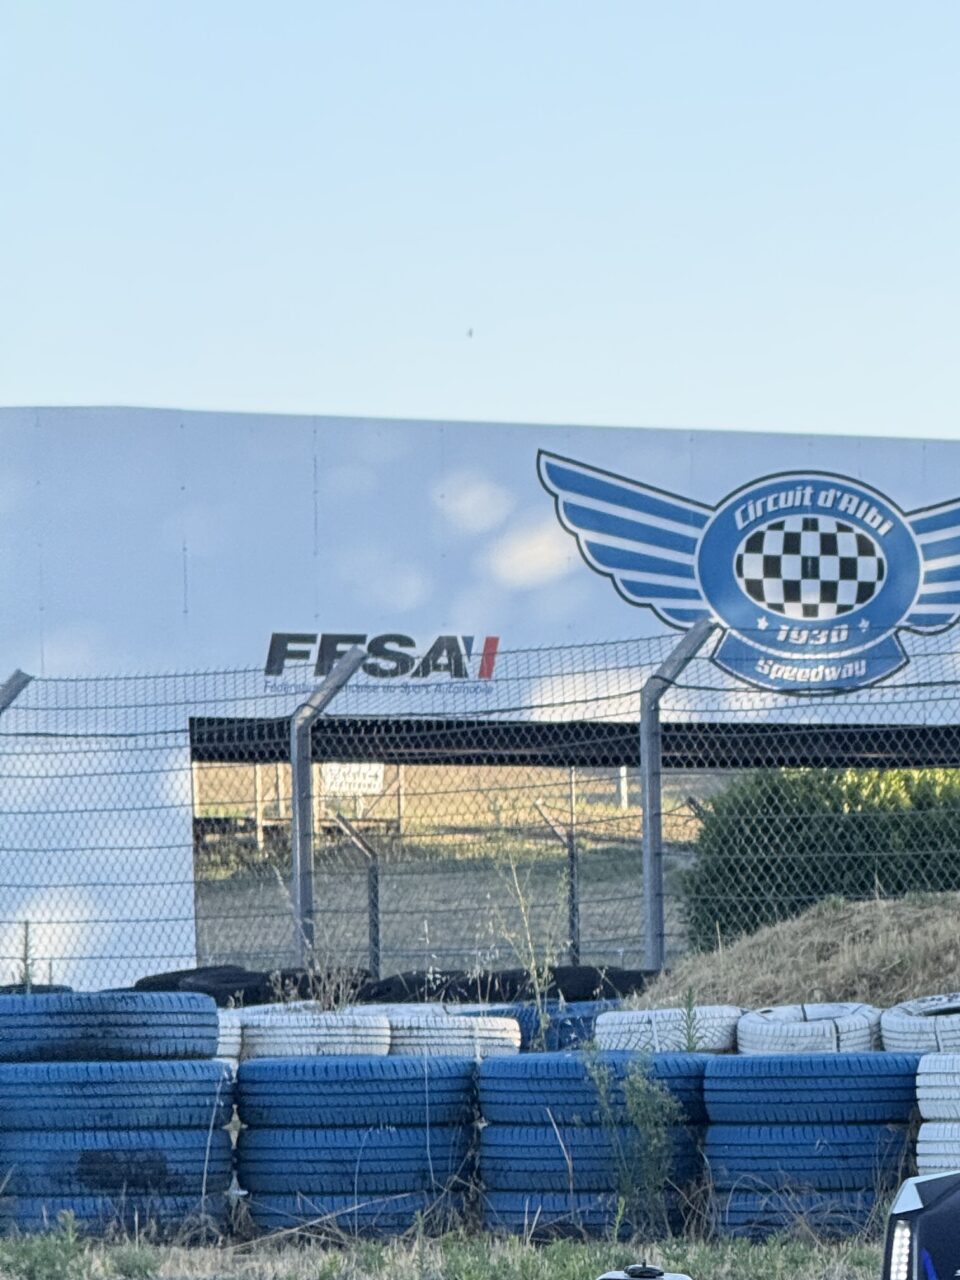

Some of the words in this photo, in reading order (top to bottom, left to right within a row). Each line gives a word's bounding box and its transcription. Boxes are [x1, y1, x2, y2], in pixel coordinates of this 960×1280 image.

[734, 486, 814, 531] Circuit
[817, 488, 895, 536] d'Albi
[776, 624, 849, 646] 1930
[755, 656, 867, 683] Speedway
